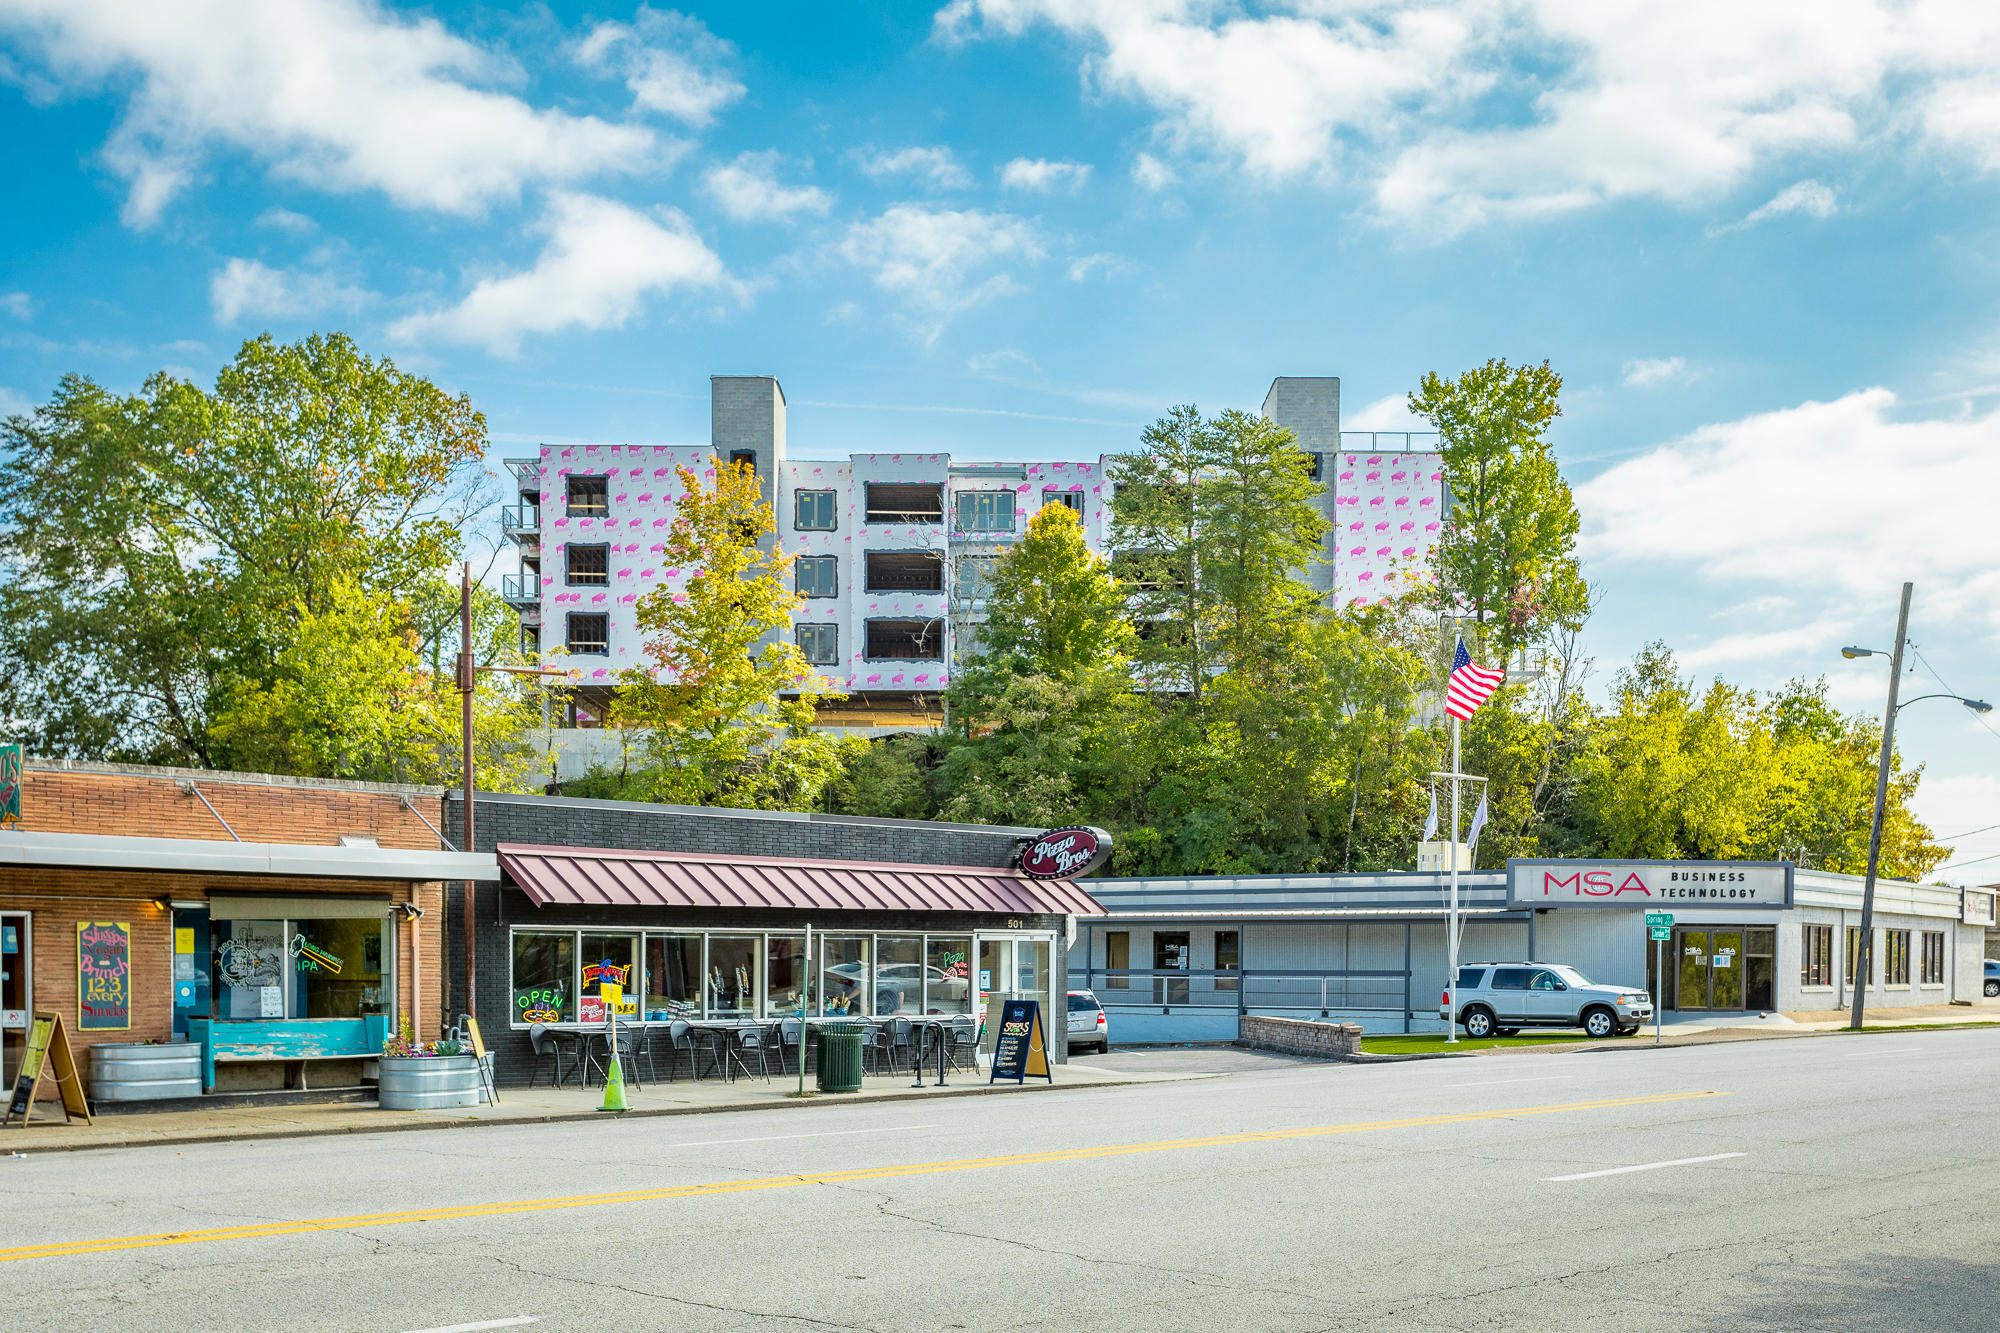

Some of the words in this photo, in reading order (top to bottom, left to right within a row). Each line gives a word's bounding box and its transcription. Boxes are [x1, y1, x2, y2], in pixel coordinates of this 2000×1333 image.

[1032, 835, 1076, 865] Pizza
[1056, 848, 1091, 874] Bros
[1544, 871, 1651, 896] MSA
[1671, 872, 1746, 882] BUSINESS
[1660, 888, 1757, 898] TECHNOLOGY
[1007, 919, 1023, 928] 501
[1646, 914, 1663, 925] Spring
[84, 945, 124, 960] Vegan
[80, 954, 129, 978] Brunch
[297, 960, 318, 971] IPA
[87, 992, 127, 1006] every
[518, 990, 563, 1008] OPEN
[81, 1000, 128, 1021] Sunday
